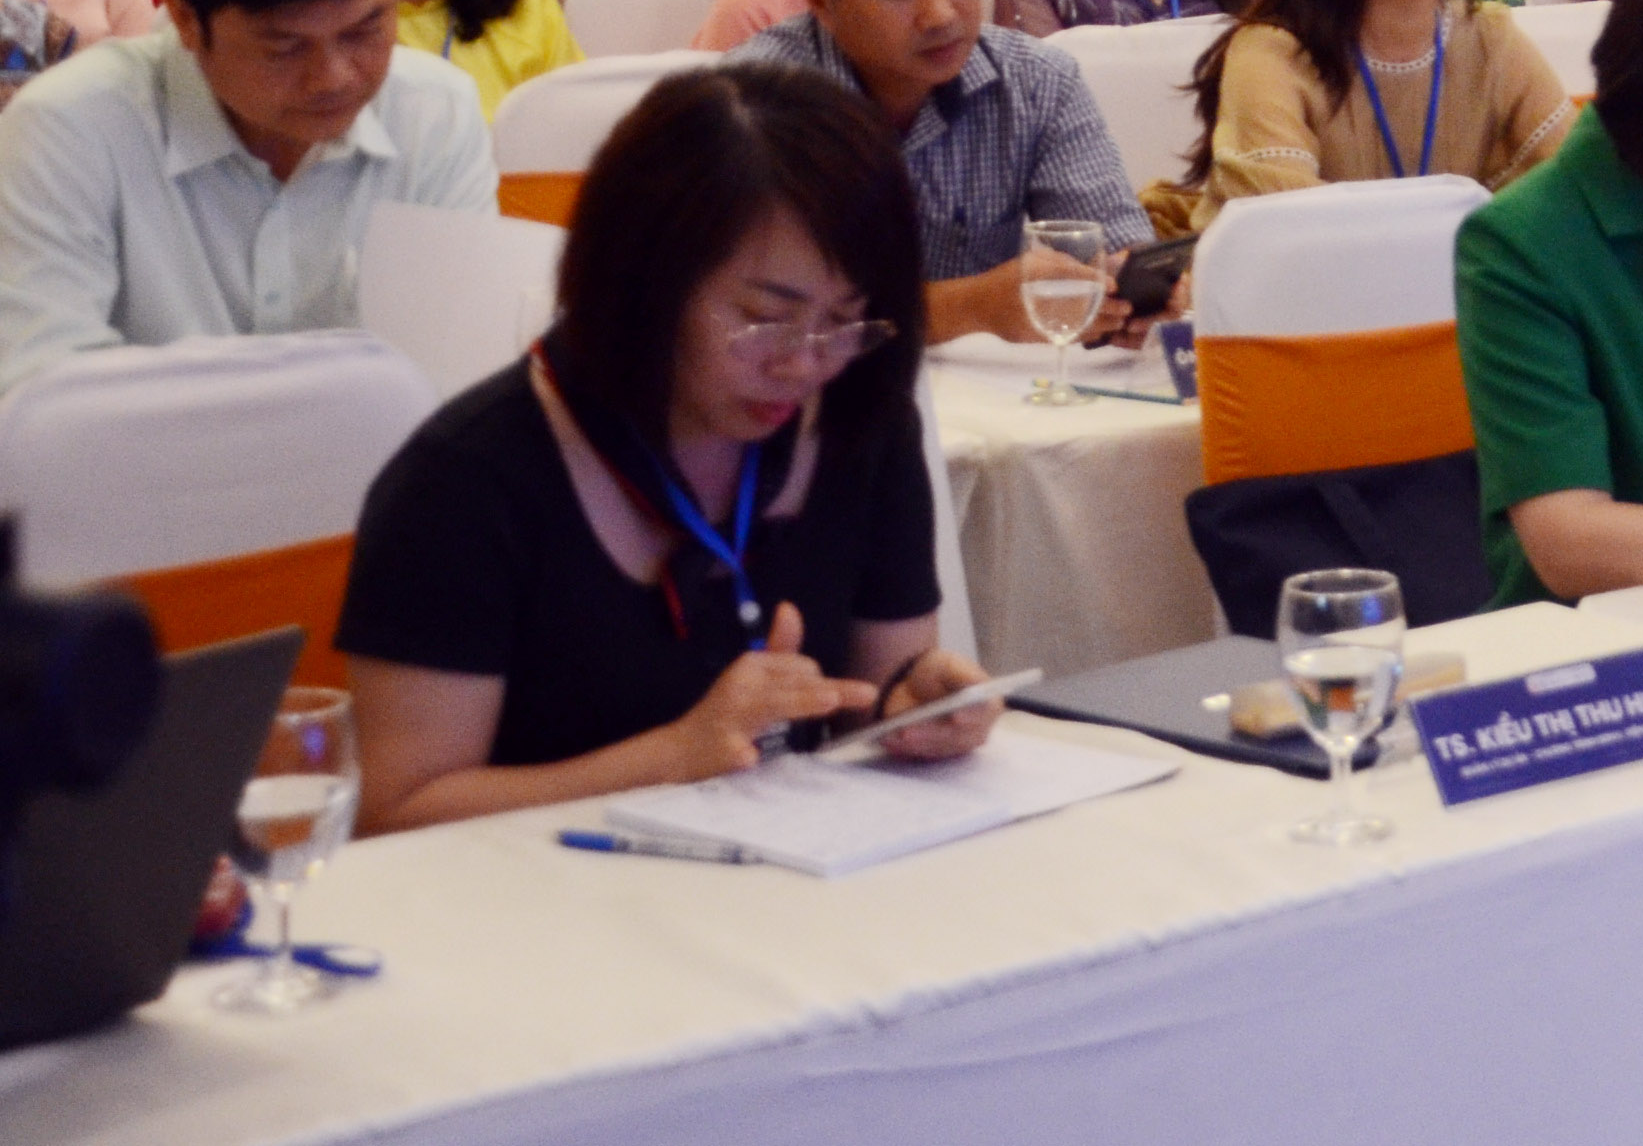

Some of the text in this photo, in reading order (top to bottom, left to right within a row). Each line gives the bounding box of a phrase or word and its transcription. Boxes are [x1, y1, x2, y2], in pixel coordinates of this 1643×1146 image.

[1434, 733, 1475, 760] TS.
[1534, 709, 1578, 737] THỊ
[1574, 697, 1624, 729] THU
